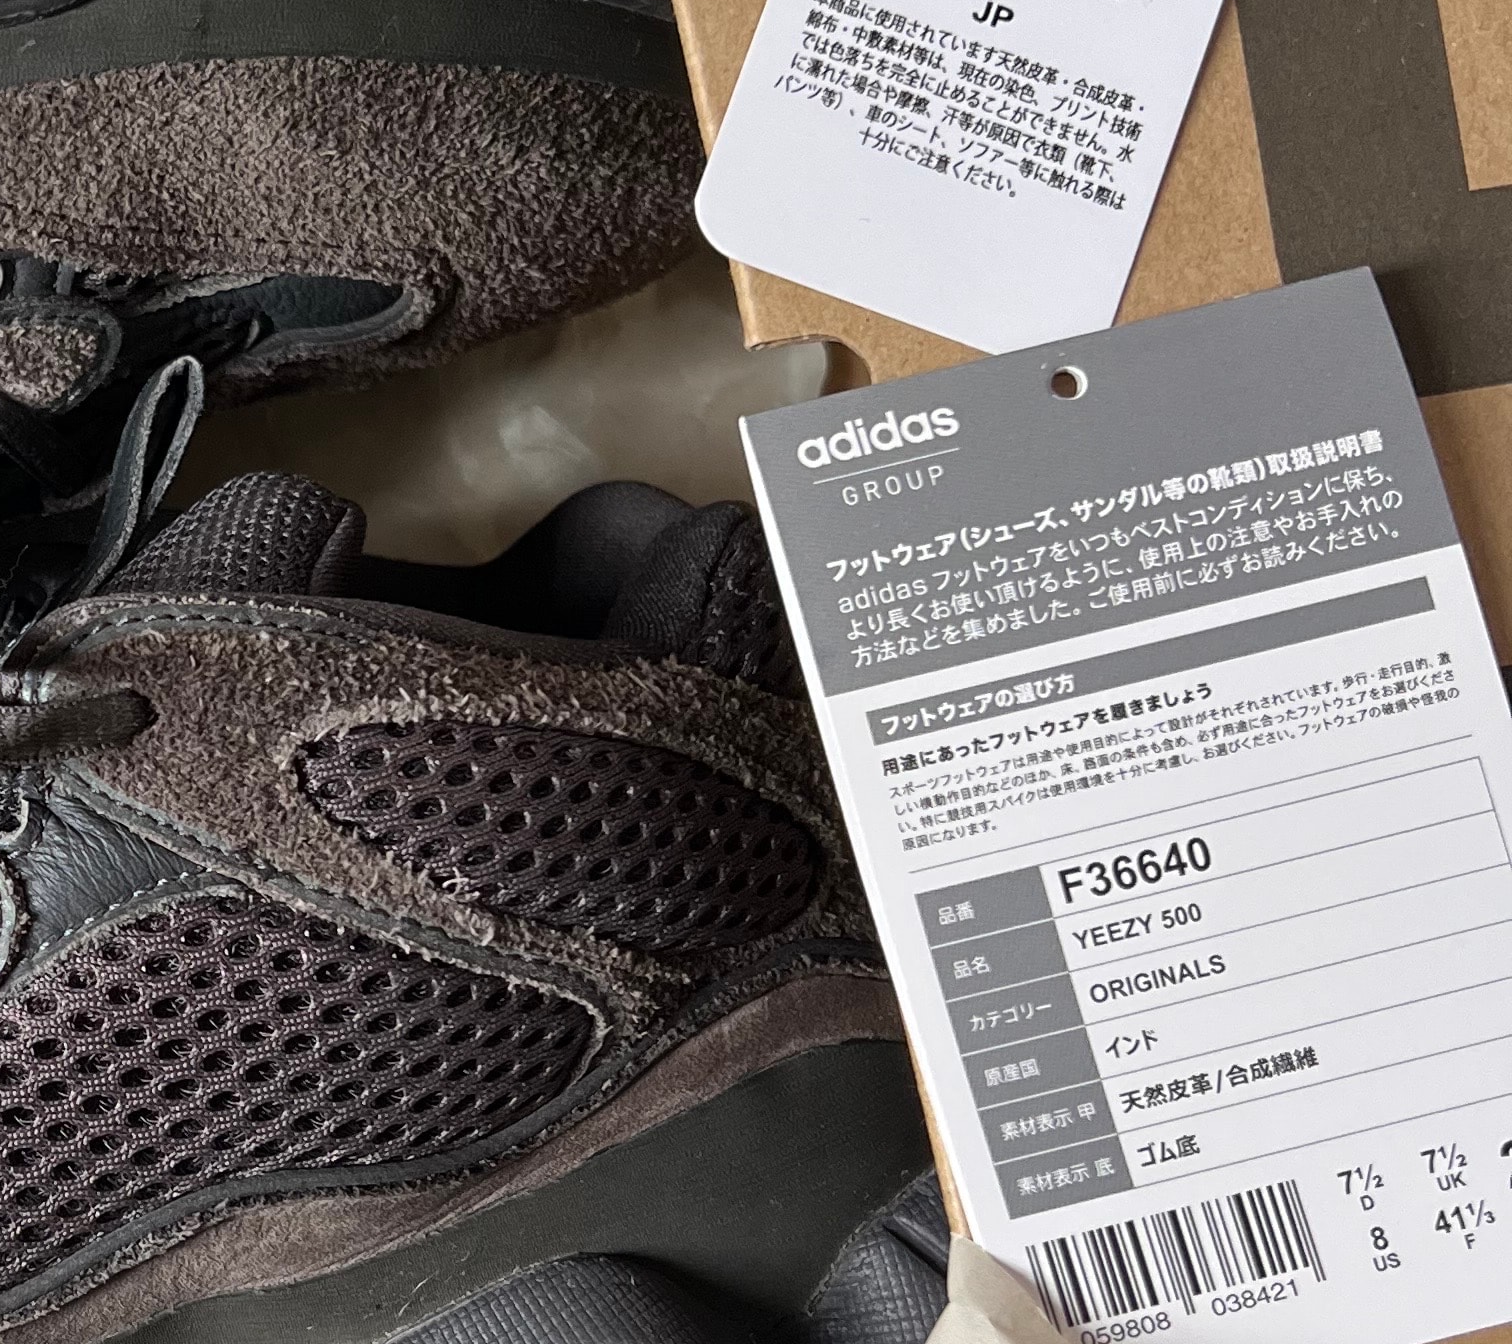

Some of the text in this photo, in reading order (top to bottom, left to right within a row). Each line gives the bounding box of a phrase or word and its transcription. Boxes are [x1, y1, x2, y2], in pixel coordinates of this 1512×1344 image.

[973, 1, 1014, 29] JP
[797, 404, 959, 470] adidas
[842, 465, 945, 507] GROUP
[838, 575, 927, 614] adidas
[881, 674, 1075, 735] フットウェアの選び方
[882, 681, 1213, 776] 用途にあったフットウェアを履きましょう
[1058, 837, 1212, 904] F36640
[938, 900, 974, 924] 品番
[1073, 902, 1202, 950] YEEZY 500
[953, 956, 990, 979] 品名
[1089, 955, 1226, 1003] ORIGINALS
[969, 1001, 1052, 1032] カテゴリー
[1104, 1029, 1159, 1060] インド
[983, 1058, 1040, 1087] 原産国
[1119, 1046, 1320, 1114] 天然皮革/合成繊維
[1137, 1134, 1201, 1168] ゴム底
[1438, 1171, 1467, 1190] UK
[1360, 1195, 1374, 1210] D
[1370, 1227, 1388, 1250] 8
[1464, 1233, 1475, 1249] F
[1373, 1253, 1400, 1271] US
[1212, 1279, 1299, 1315] 038421
